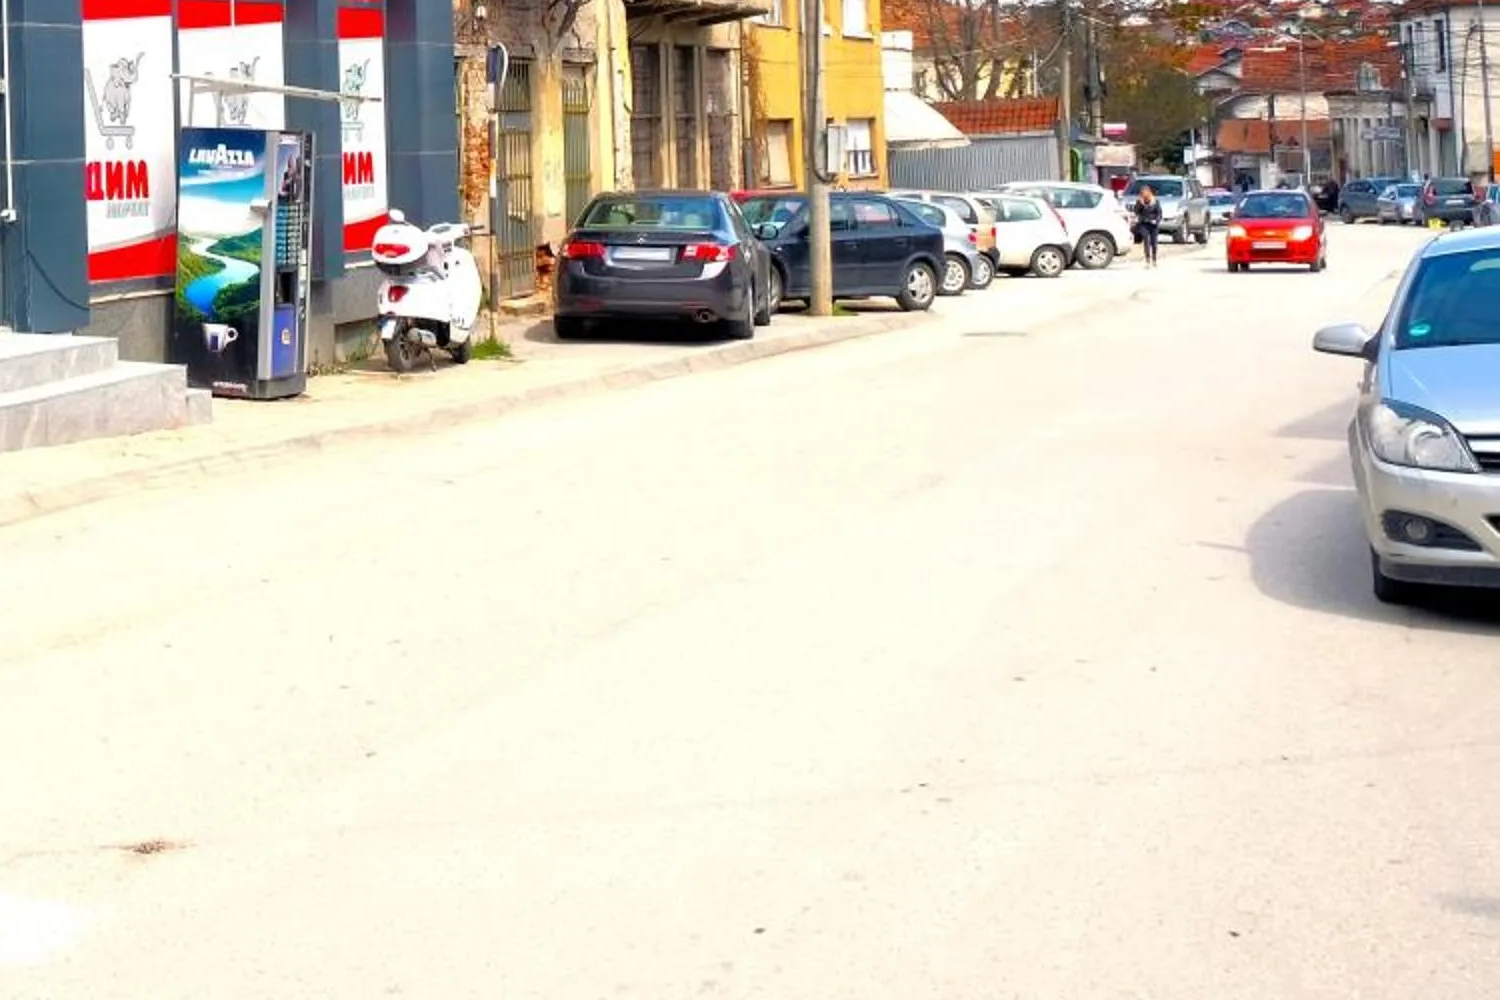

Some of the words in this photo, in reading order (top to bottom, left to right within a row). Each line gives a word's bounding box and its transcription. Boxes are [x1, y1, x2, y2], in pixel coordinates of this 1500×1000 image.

[188, 143, 255, 166] LAVAZZA
[342, 151, 375, 185] ИМ
[84, 160, 149, 201] ДИМ
